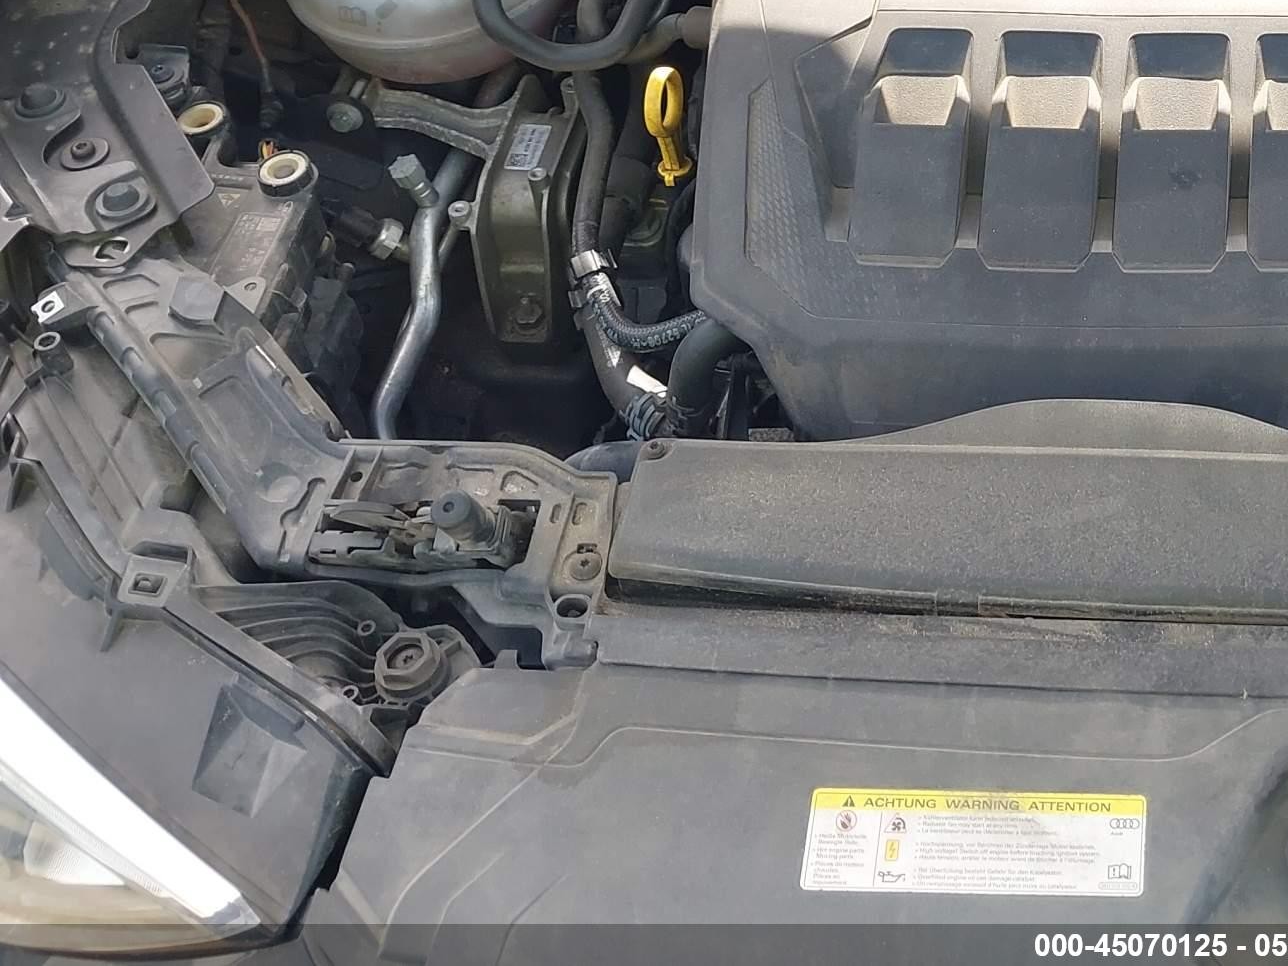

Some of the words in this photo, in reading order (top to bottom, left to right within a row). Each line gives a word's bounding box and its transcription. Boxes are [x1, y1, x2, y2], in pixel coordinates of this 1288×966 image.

[863, 798, 936, 810] ACHTUNG
[945, 799, 1020, 812] WARNING
[1028, 801, 1111, 813] ATTENTION
